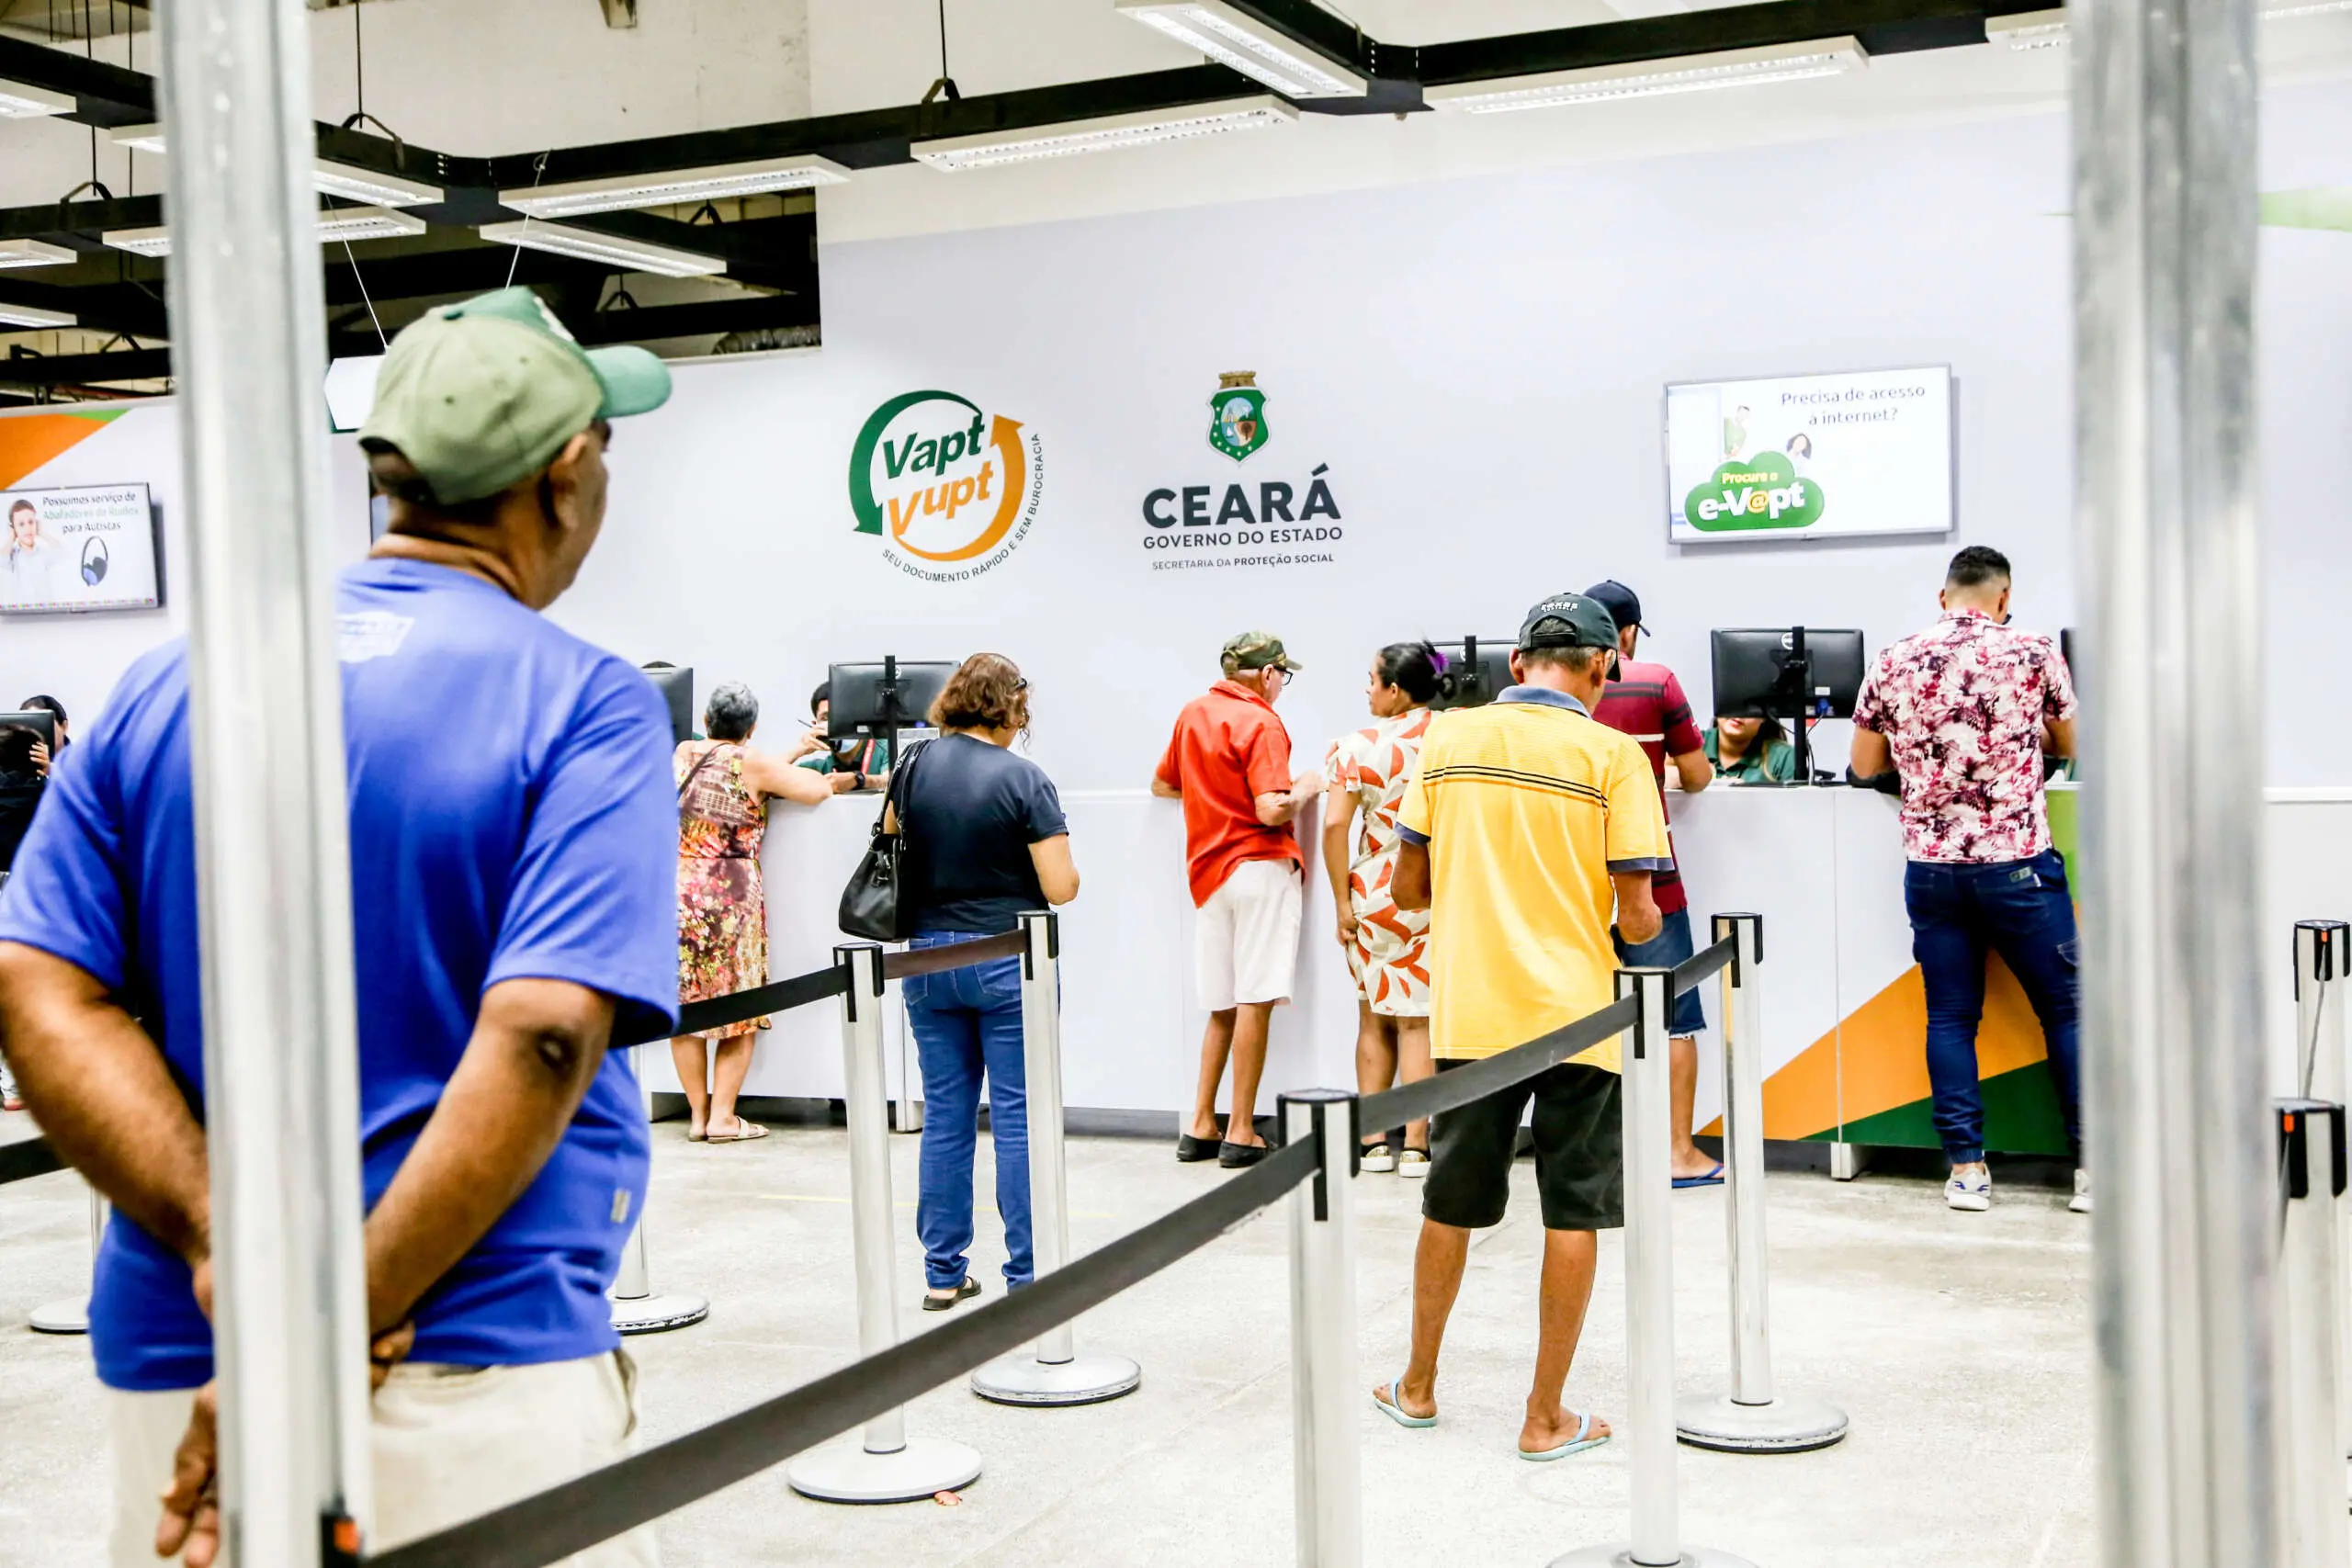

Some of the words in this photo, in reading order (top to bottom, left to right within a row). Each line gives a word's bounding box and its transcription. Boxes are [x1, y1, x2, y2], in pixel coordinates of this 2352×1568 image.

[1781, 389, 1840, 405] Precisa
[1845, 387, 1865, 402] de
[1869, 386, 1926, 400] acesso
[1823, 407, 1898, 425] internet?
[883, 413, 985, 479] Vapt
[1722, 471, 1769, 484] Procure
[1770, 472, 1779, 482] o
[124, 491, 136, 502] de
[888, 460, 993, 537] Vupt
[1142, 462, 1341, 529] CEARÁ
[1698, 481, 1805, 521] e-V@pt
[882, 549, 902, 568] SEU
[903, 563, 970, 582] DOCUMENTO
[1008, 541, 1017, 551] E
[1015, 517, 1033, 541] SEM
[1028, 434, 1044, 515] BUROCRACIA
[62, 524, 83, 535] para
[85, 521, 121, 532] Autistas
[1143, 533, 1232, 549] GOVERNO
[1238, 530, 1264, 545] DO
[1271, 526, 1342, 543] ESTADO
[1152, 558, 1215, 570] SECRETARIA
[1216, 558, 1231, 567] DA
[1234, 553, 1292, 568] PROTEÇÃO
[1295, 553, 1334, 564] SOCIAL
